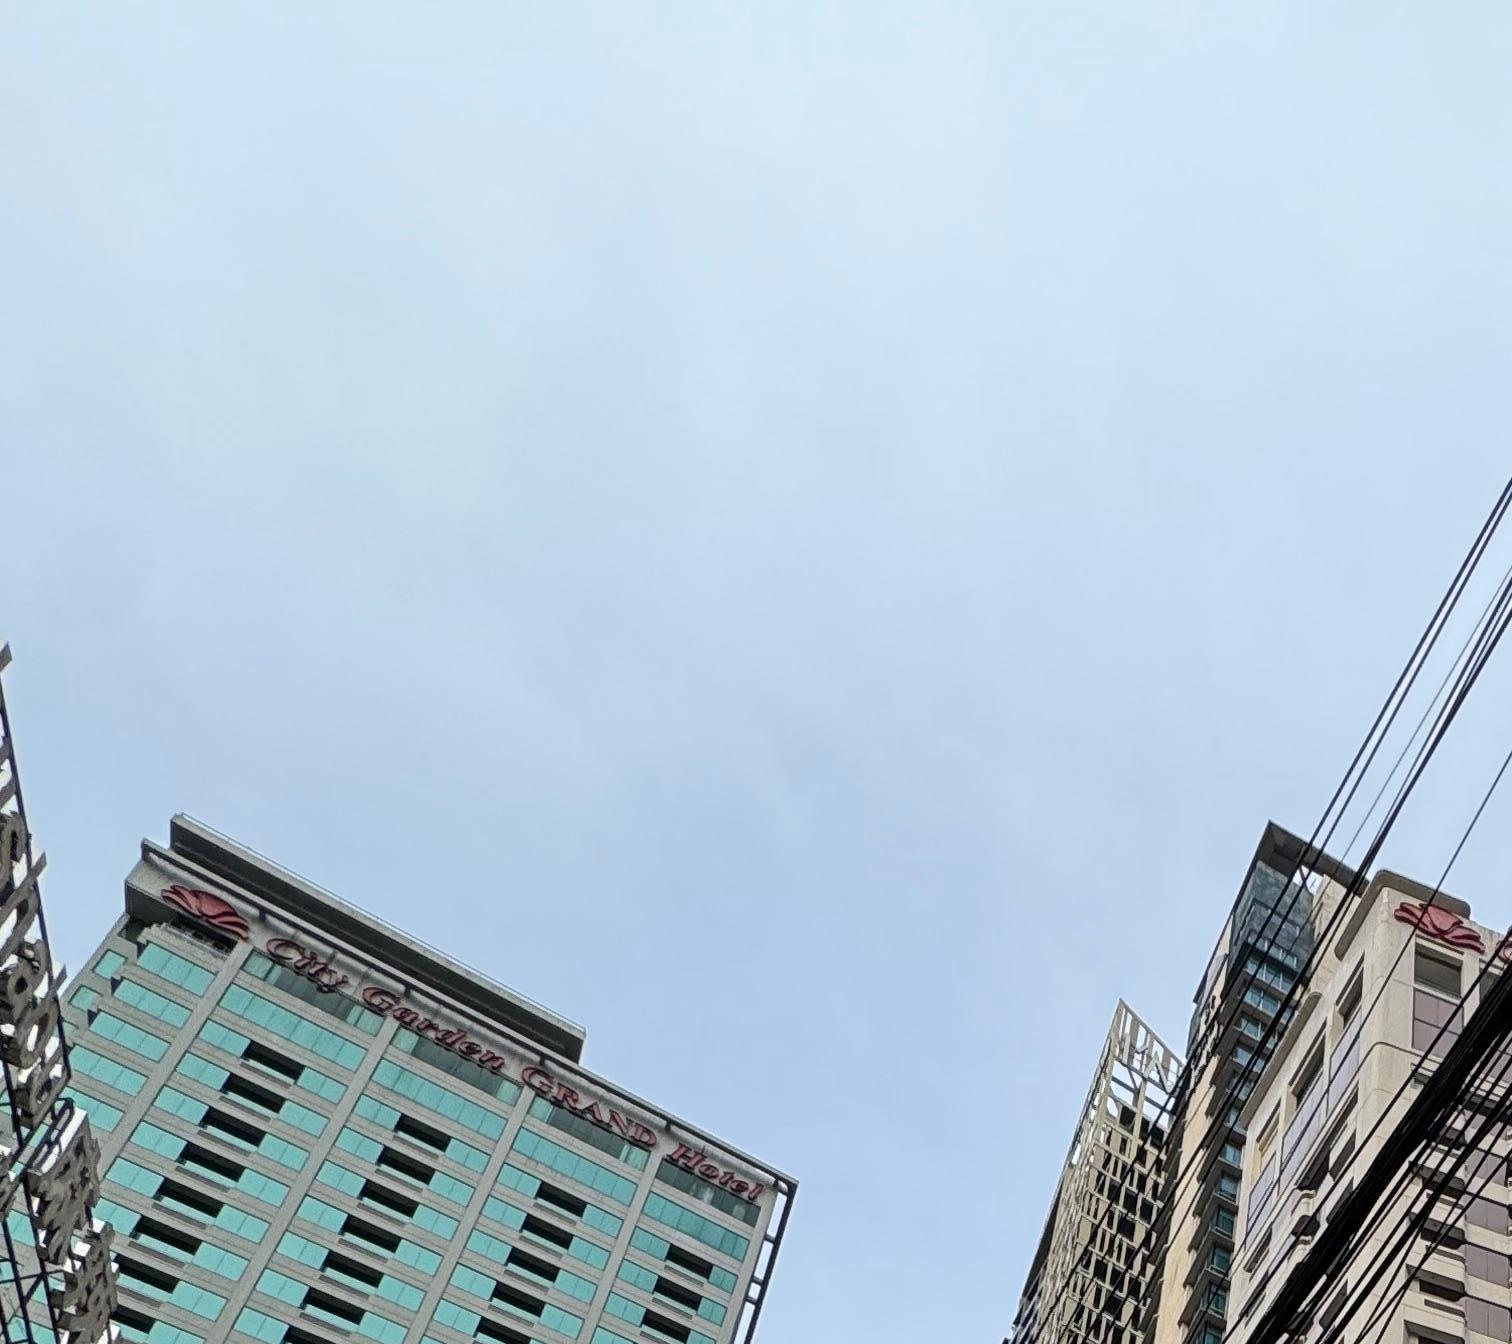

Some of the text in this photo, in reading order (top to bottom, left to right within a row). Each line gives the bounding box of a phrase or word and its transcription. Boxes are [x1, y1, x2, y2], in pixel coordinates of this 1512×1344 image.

[266, 937, 764, 1201] City Garden GRAND Hotel
